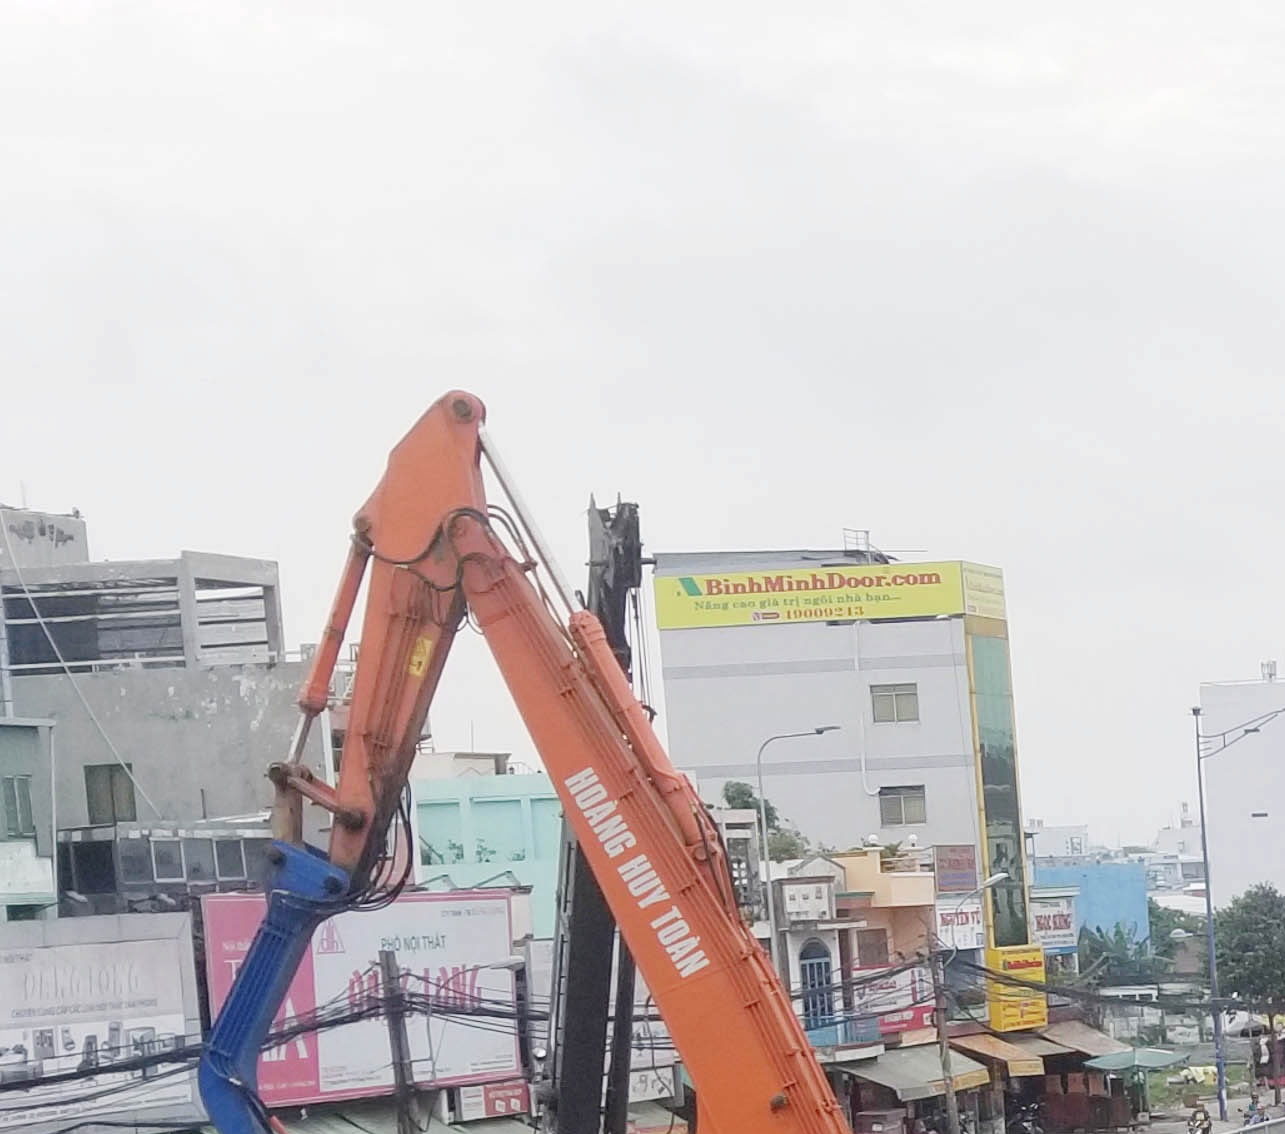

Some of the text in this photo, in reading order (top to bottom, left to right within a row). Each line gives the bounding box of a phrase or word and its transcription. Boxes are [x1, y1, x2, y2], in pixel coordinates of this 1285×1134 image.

[705, 571, 941, 597] BinhMinhDoor.com
[732, 600, 755, 609] cao
[565, 767, 711, 978] HOÀNG HUY TOÀN
